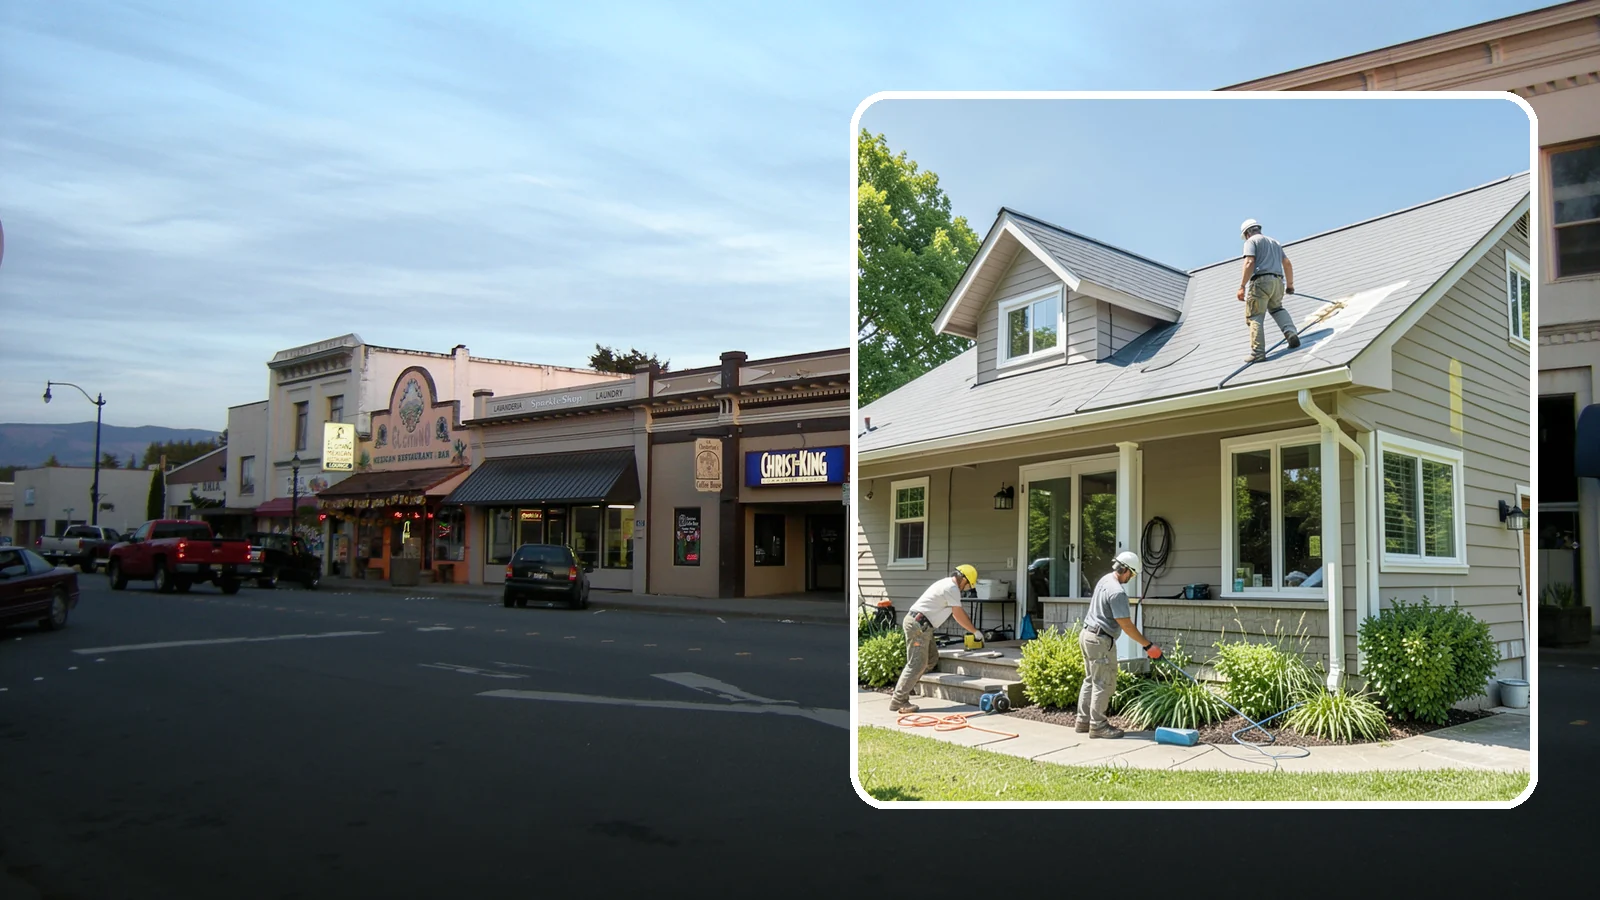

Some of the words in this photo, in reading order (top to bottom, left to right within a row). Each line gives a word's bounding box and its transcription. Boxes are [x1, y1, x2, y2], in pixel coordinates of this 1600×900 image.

[561, 394, 582, 406] Shop
[595, 389, 624, 400] LAUNDRY
[493, 402, 522, 412] LAVANDERIA
[373, 454, 396, 464] MEXICAN
[397, 451, 433, 463] RESTAURANT
[437, 450, 450, 459] BAR
[760, 452, 798, 478] CHRIST
[799, 450, 827, 476] KING
[696, 480, 709, 488] Coffee
